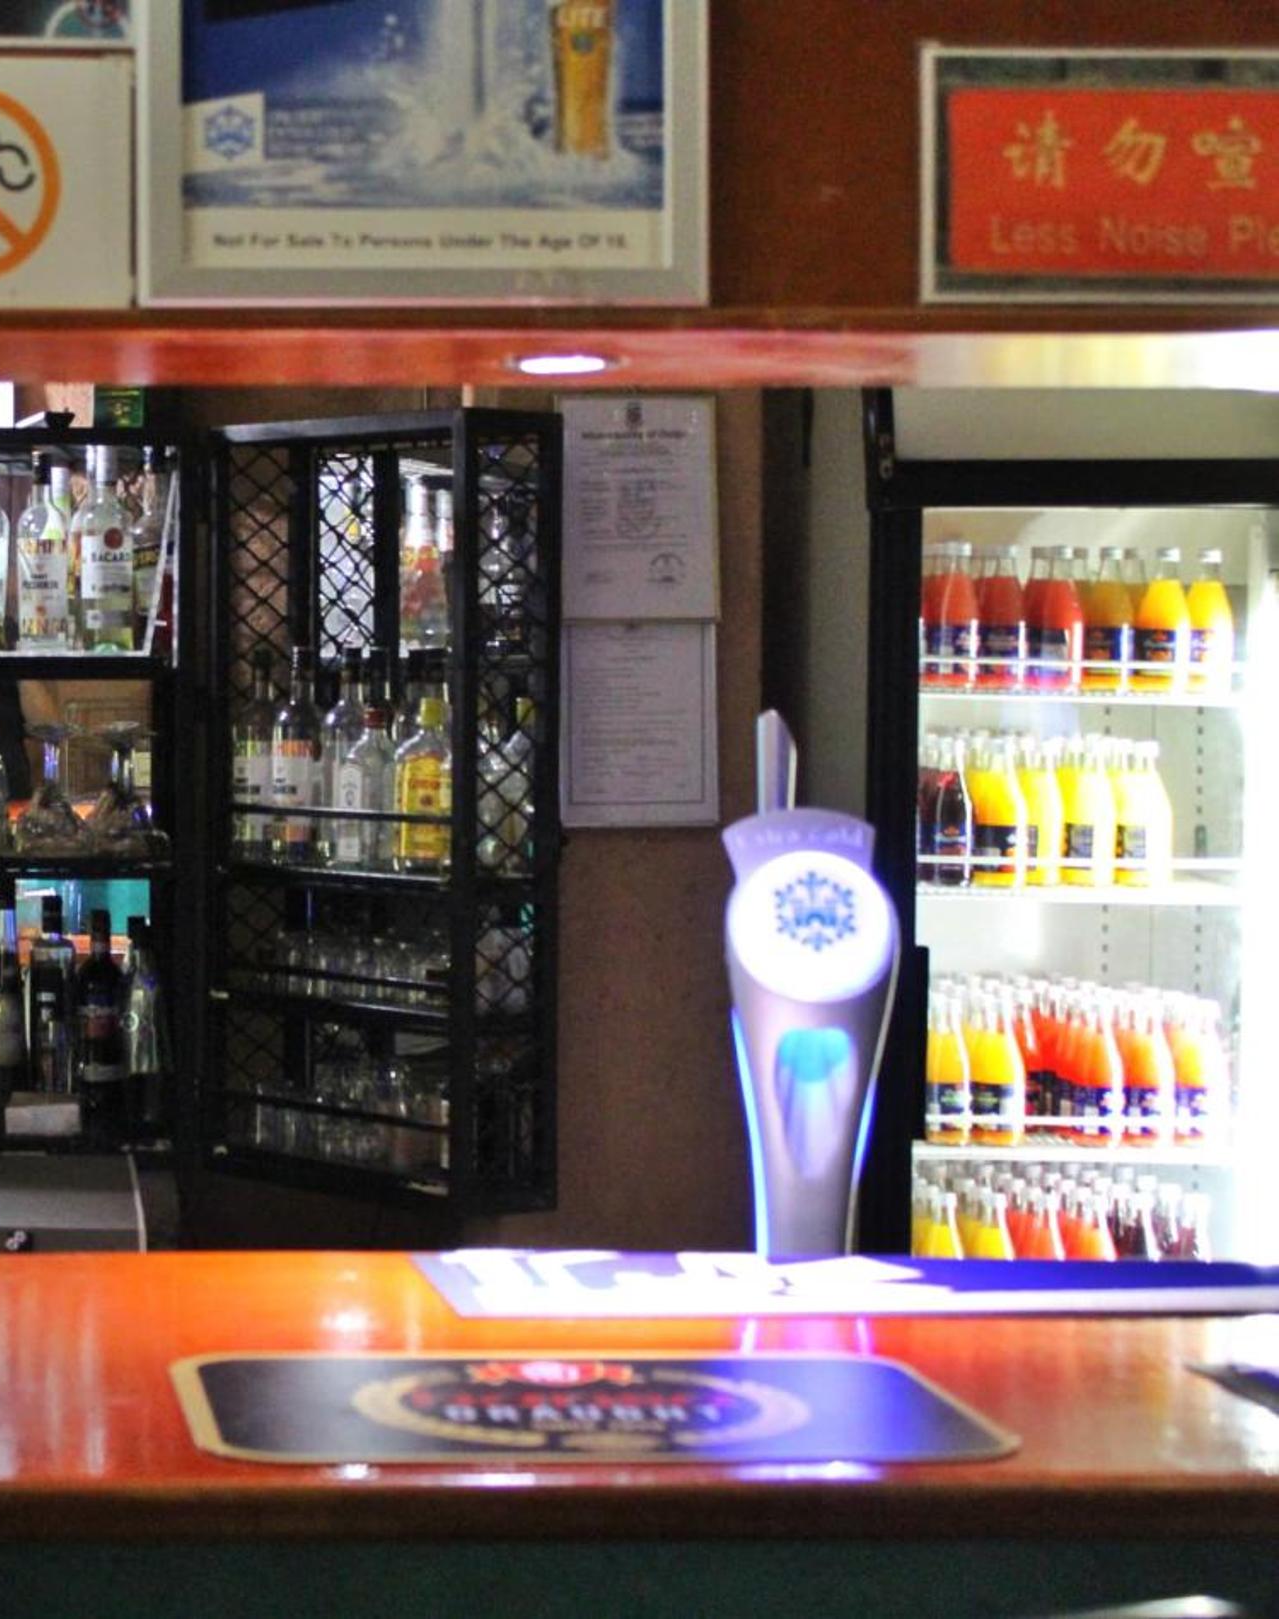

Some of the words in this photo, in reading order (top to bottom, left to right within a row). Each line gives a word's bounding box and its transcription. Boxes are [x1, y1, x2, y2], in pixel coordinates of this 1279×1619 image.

[213, 233, 246, 248] Not
[250, 233, 279, 248] For
[287, 233, 324, 248] Sale
[332, 233, 352, 248] To
[360, 233, 432, 249] Persons
[439, 233, 492, 249] Under
[500, 233, 532, 249] The
[539, 233, 574, 253] Age
[992, 215, 1079, 255] Less
[1100, 216, 1208, 256] Noise
